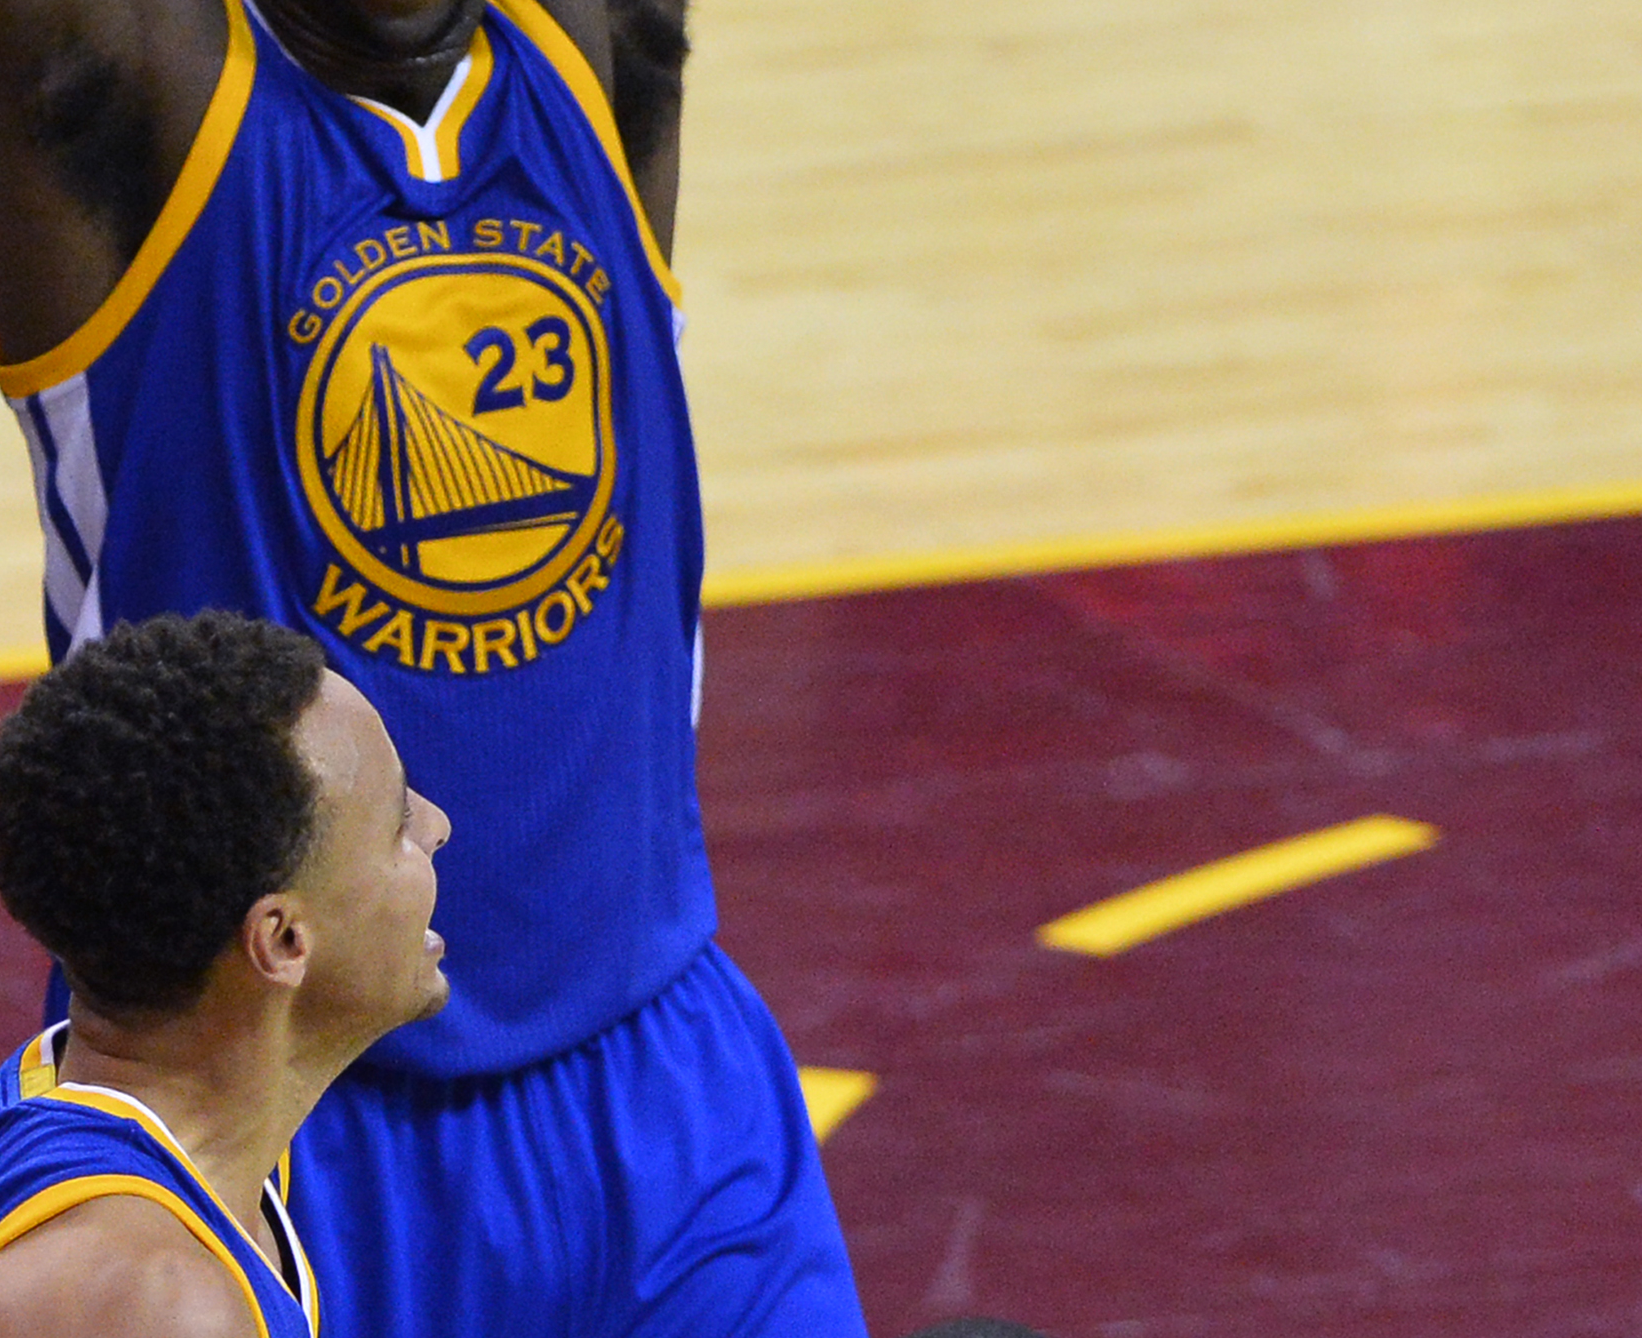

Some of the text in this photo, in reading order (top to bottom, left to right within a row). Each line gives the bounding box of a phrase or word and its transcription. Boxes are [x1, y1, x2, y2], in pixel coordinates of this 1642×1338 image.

[287, 217, 611, 344] GOLDEN STATE
[462, 315, 576, 419] 23
[310, 513, 625, 674] WARRIORS
